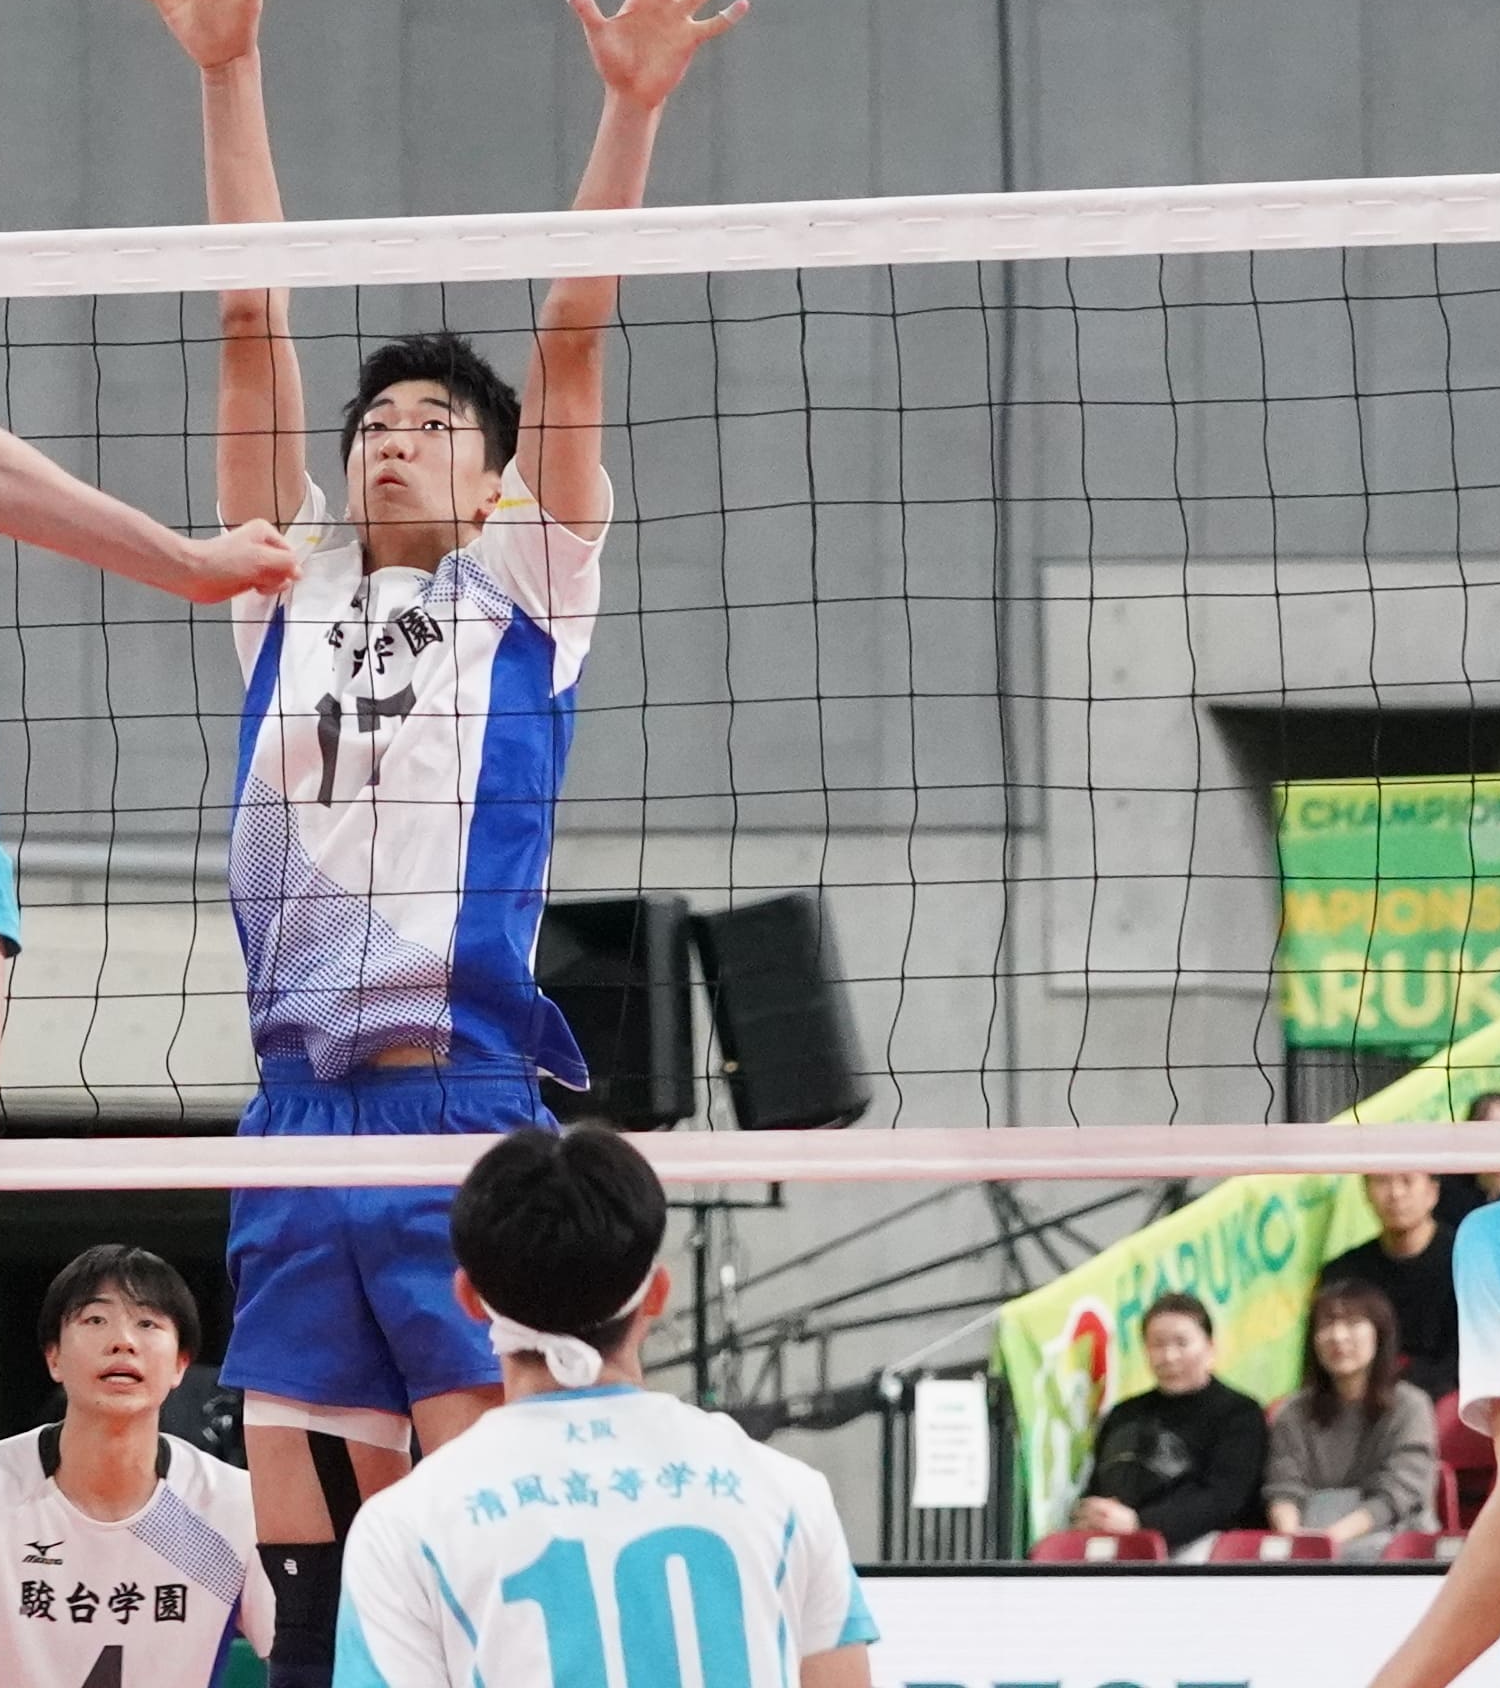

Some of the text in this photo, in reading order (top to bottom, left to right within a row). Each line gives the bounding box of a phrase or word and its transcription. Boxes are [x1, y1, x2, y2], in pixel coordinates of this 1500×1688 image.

[565, 1417, 617, 1444] 大阪
[465, 1461, 746, 1526] 清風高等学校
[19, 1579, 188, 1626] 駿台学園
[501, 1525, 752, 1688] 10
